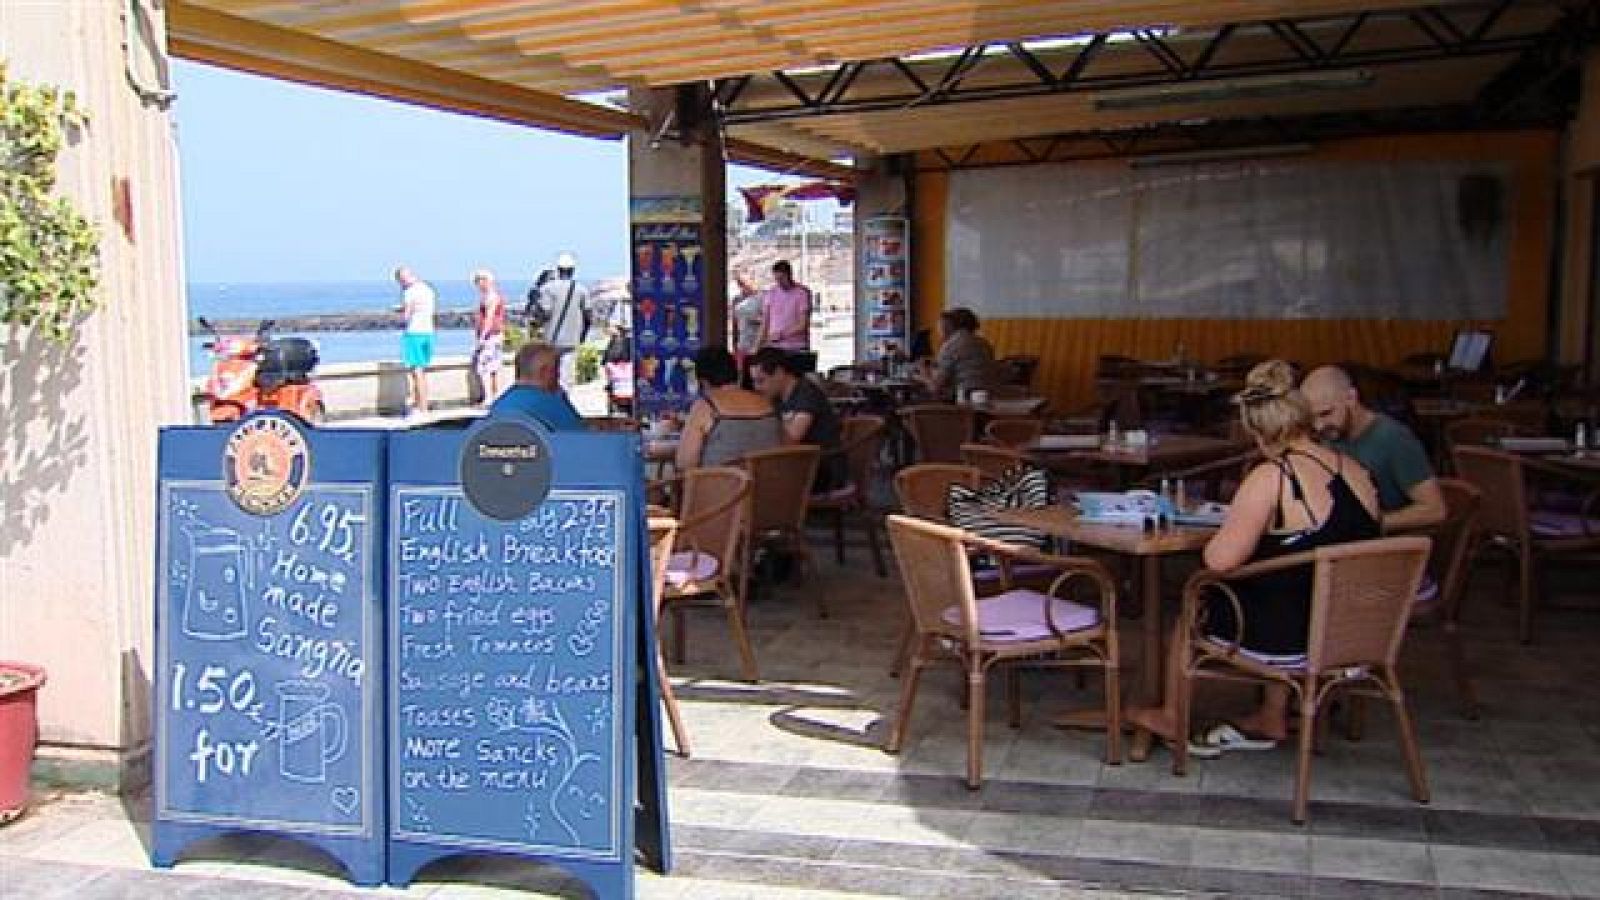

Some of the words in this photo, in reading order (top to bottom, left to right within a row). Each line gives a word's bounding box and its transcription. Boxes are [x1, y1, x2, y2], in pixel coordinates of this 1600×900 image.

[402, 496, 459, 533] Full
[400, 531, 493, 571] English
[271, 551, 348, 594] Home
[400, 573, 442, 599] Two
[262, 583, 340, 628] made
[400, 603, 438, 626] Two
[255, 617, 365, 685] Sangria
[190, 729, 260, 783] for
[437, 765, 471, 790] the
